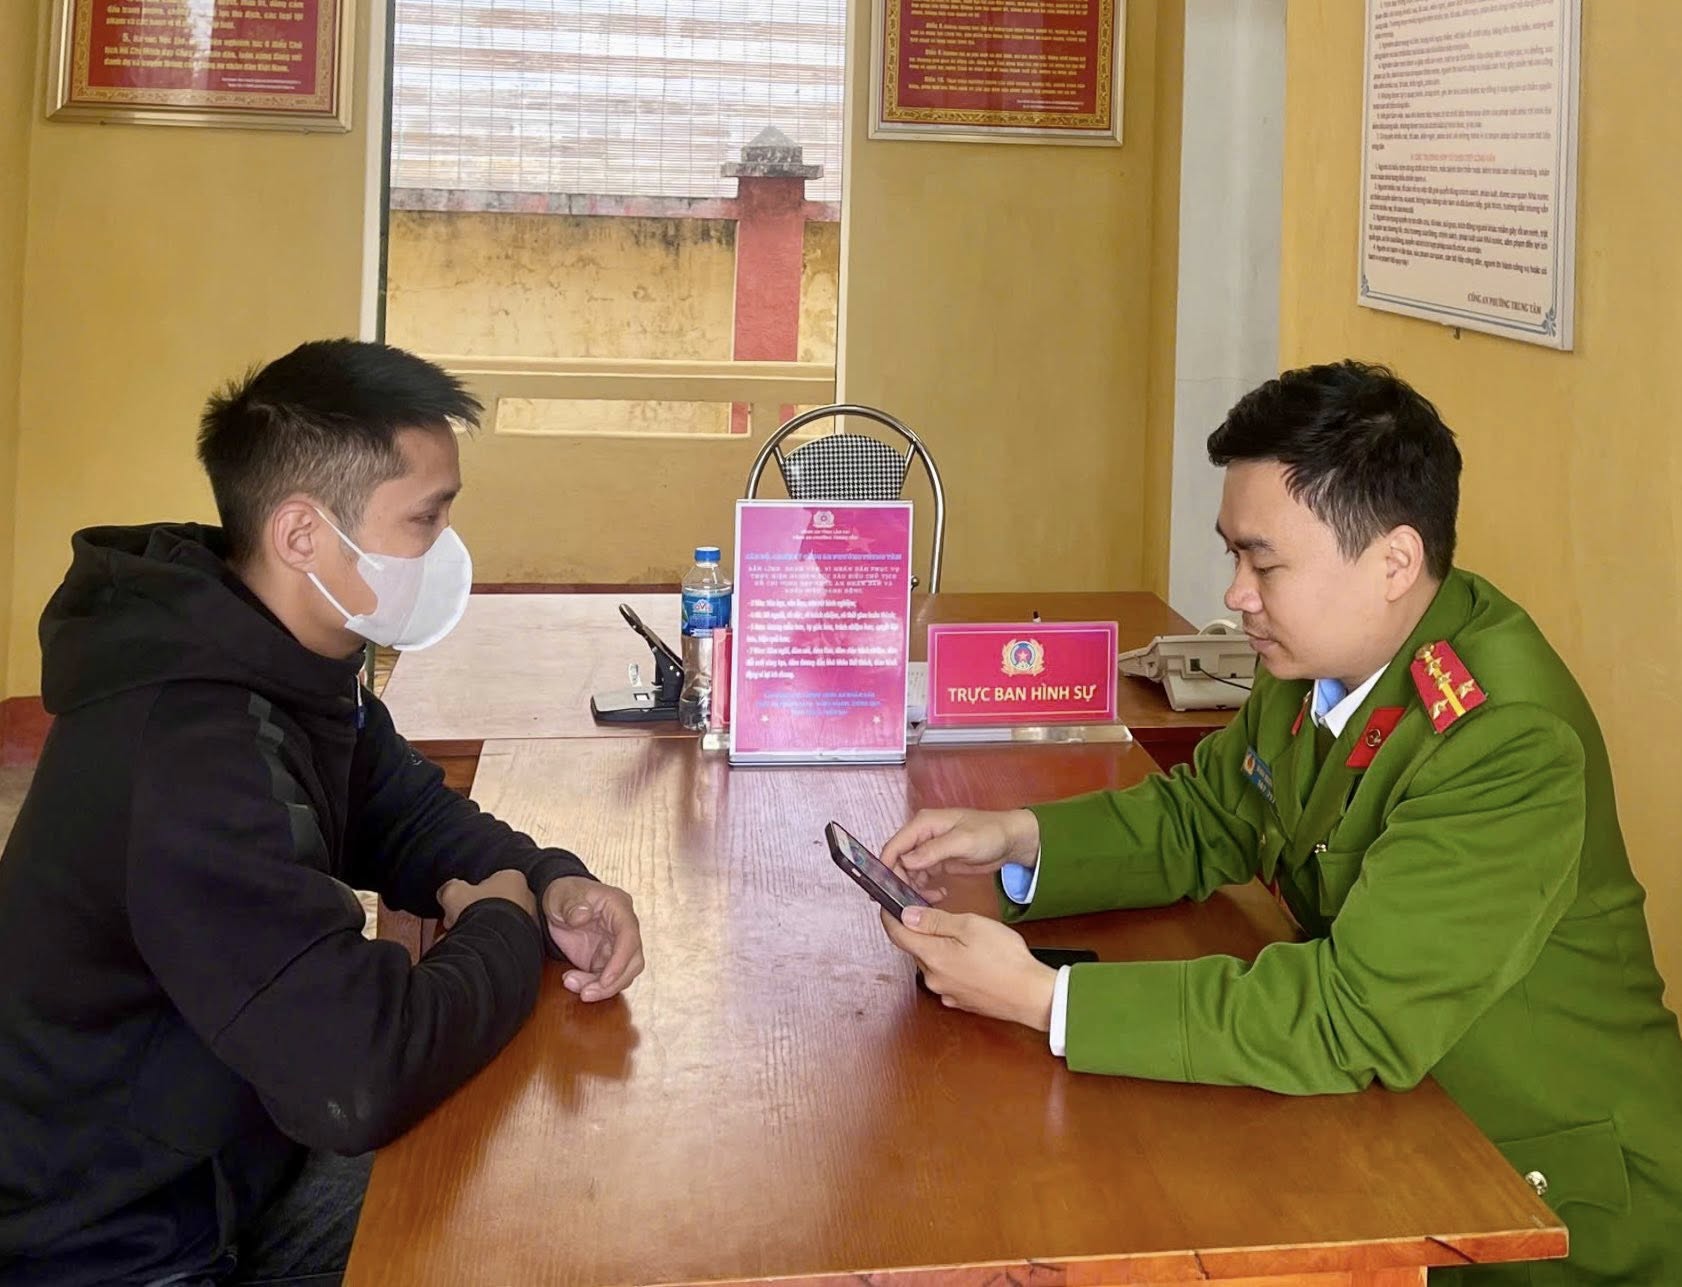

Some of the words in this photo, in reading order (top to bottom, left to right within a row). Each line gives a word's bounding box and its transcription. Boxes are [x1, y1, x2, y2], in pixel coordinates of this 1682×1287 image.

[1467, 292, 1481, 304] CÔNG
[947, 686, 990, 704] TRỰC
[994, 686, 1027, 701] BAN
[1031, 682, 1070, 700] HÌNH
[1073, 684, 1097, 702] SỰ
